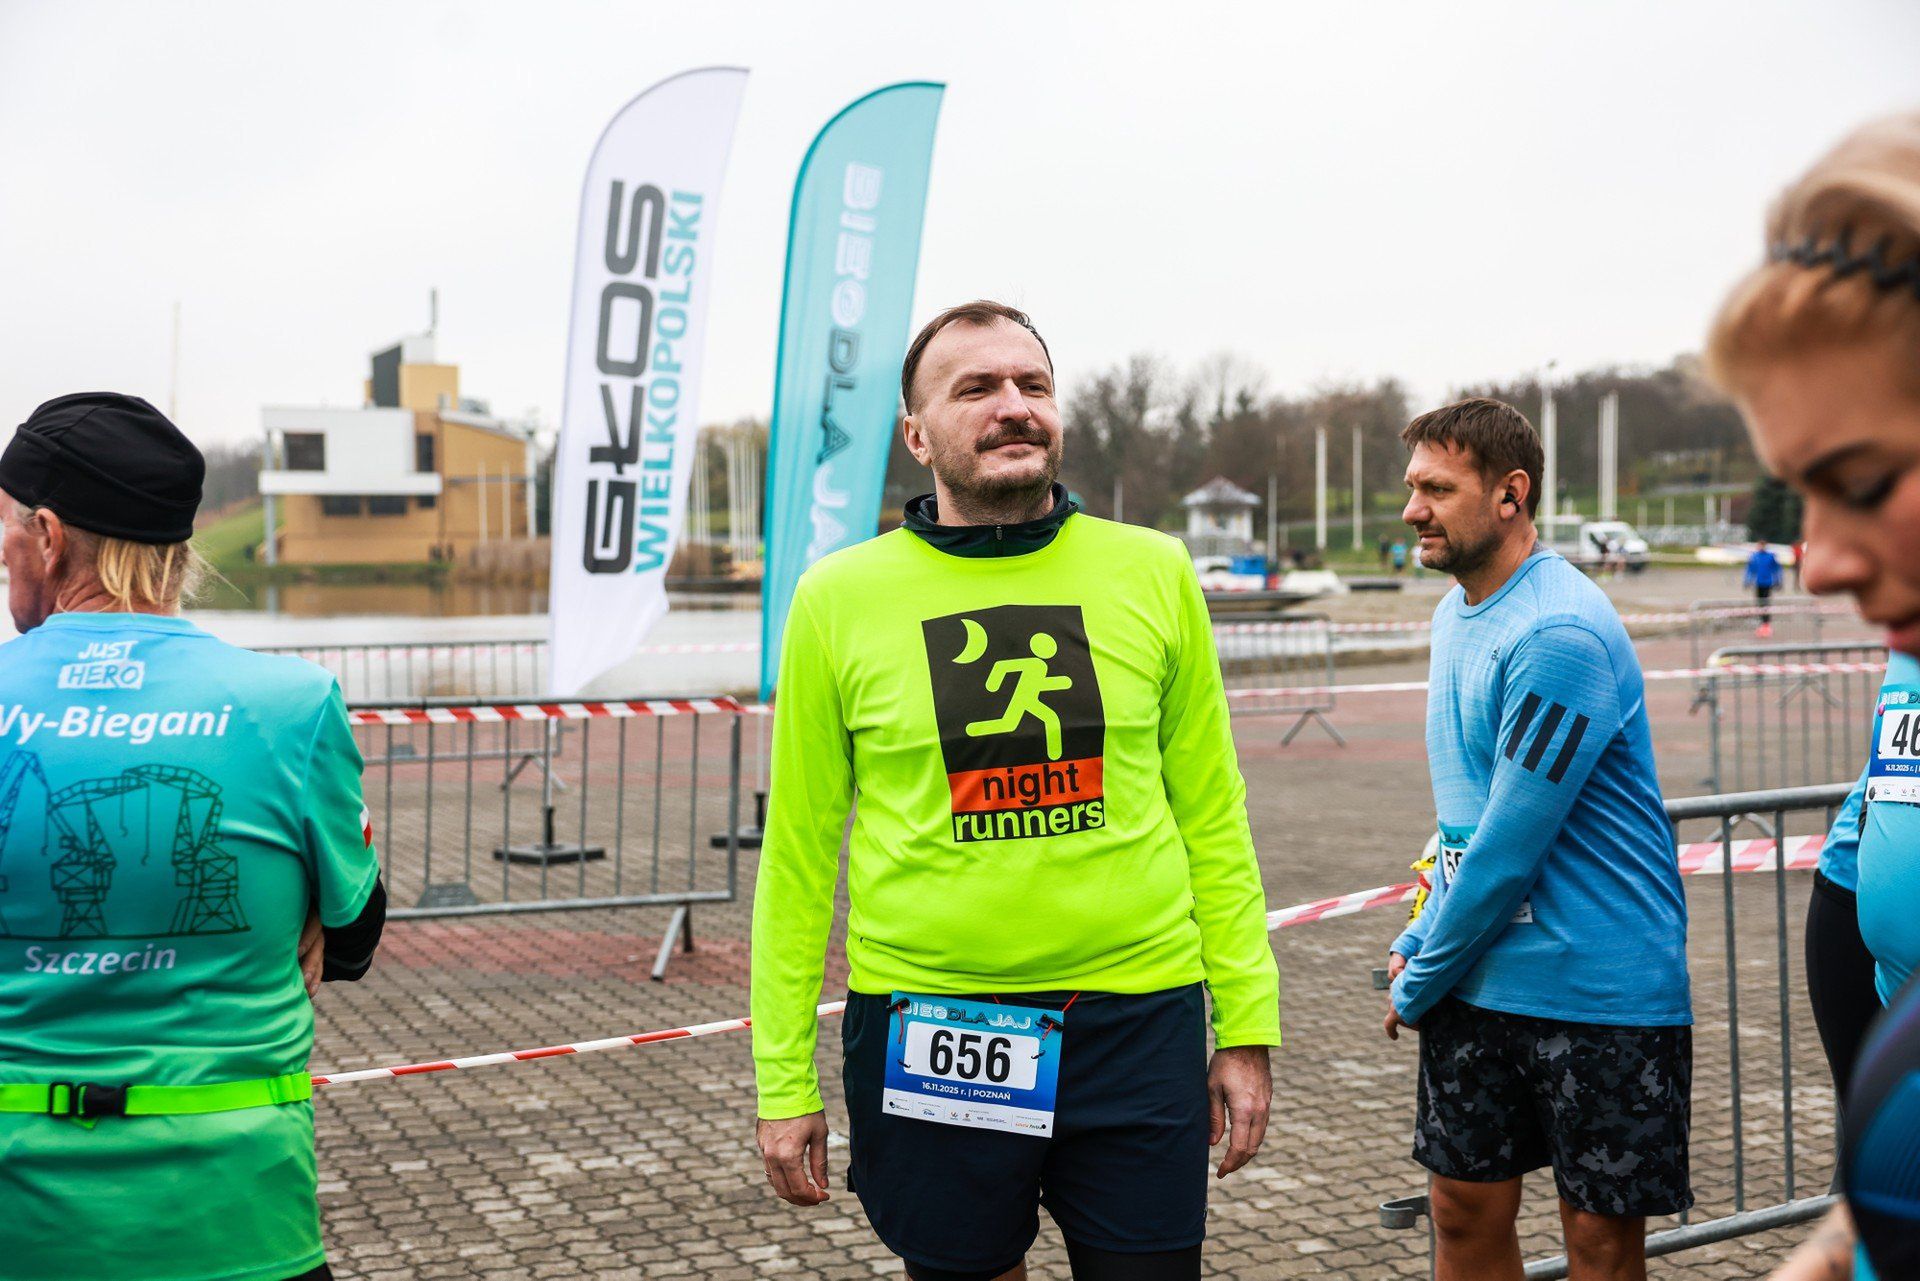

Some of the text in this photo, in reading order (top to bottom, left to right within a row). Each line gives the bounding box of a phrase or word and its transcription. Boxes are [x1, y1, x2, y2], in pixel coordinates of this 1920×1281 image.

[583, 180, 666, 574] GŁOS
[635, 189, 704, 574] WIELKOPOLSKI
[77, 640, 139, 660] JUST
[67, 663, 140, 687] HERO
[983, 762, 1080, 806] night
[954, 800, 1104, 841] runners
[25, 943, 177, 974] Szczecin
[930, 1029, 1012, 1083] 656
[922, 1081, 959, 1095] 16.11.2025
[973, 1088, 1011, 1100] POZNAŃ
